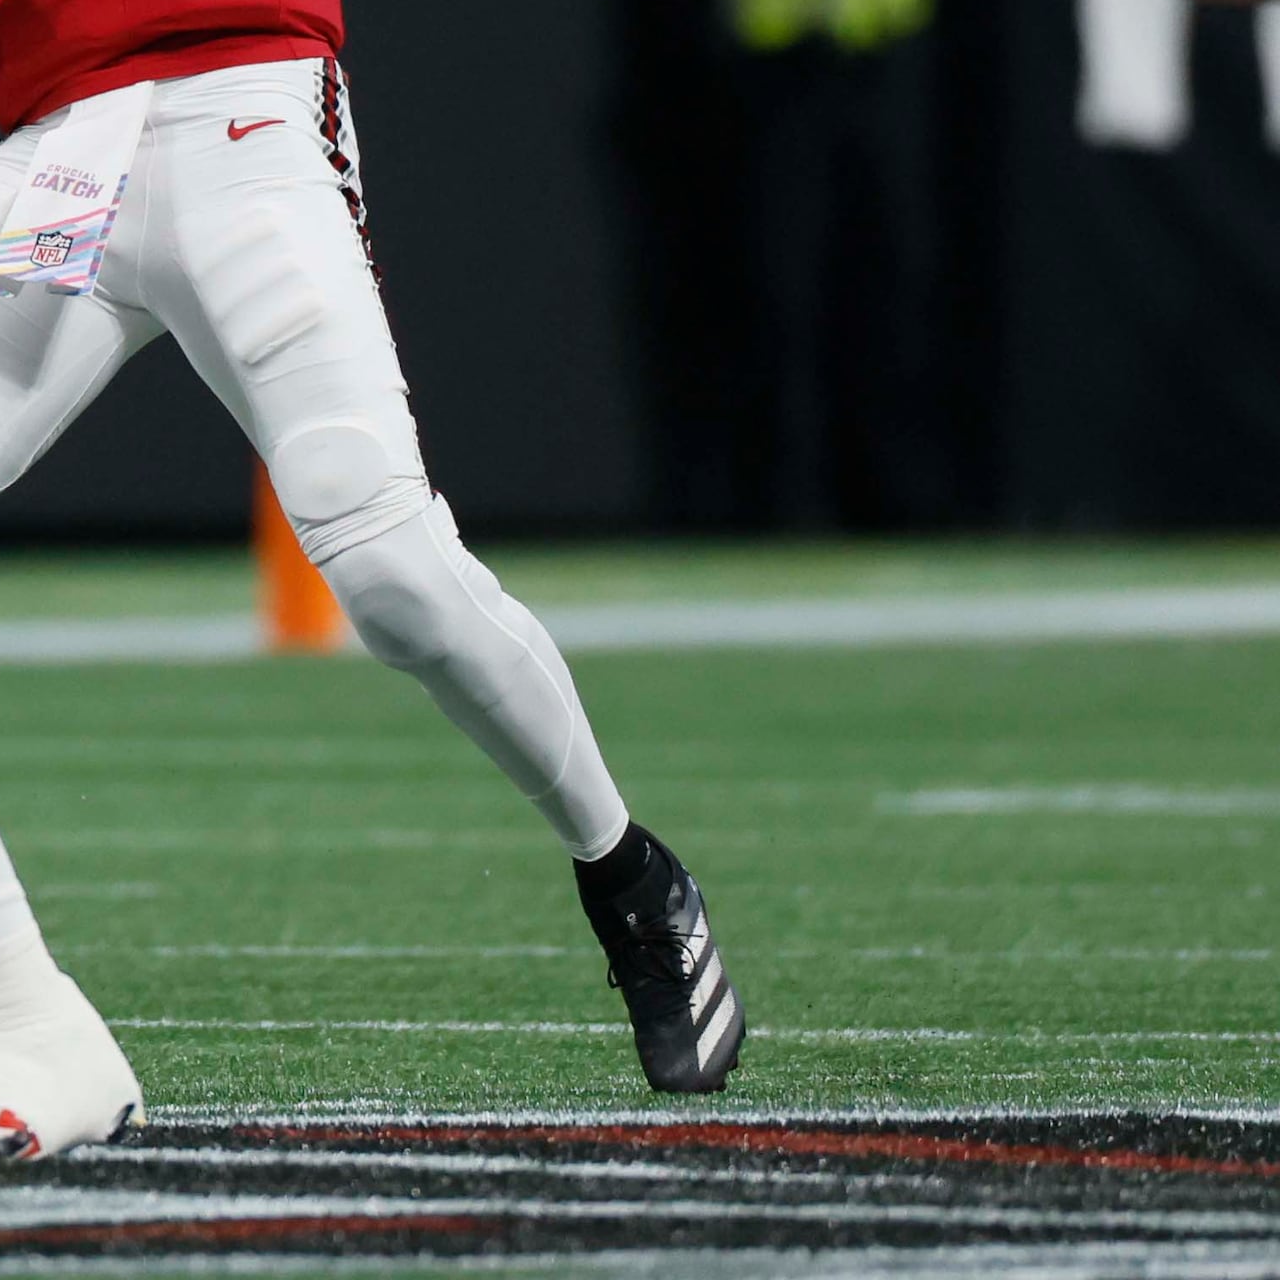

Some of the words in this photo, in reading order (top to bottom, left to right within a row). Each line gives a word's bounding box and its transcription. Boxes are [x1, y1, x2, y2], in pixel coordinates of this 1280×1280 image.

[46, 163, 97, 182] CRUCIAL
[30, 172, 105, 199] CATCH
[34, 248, 63, 263] NFL
